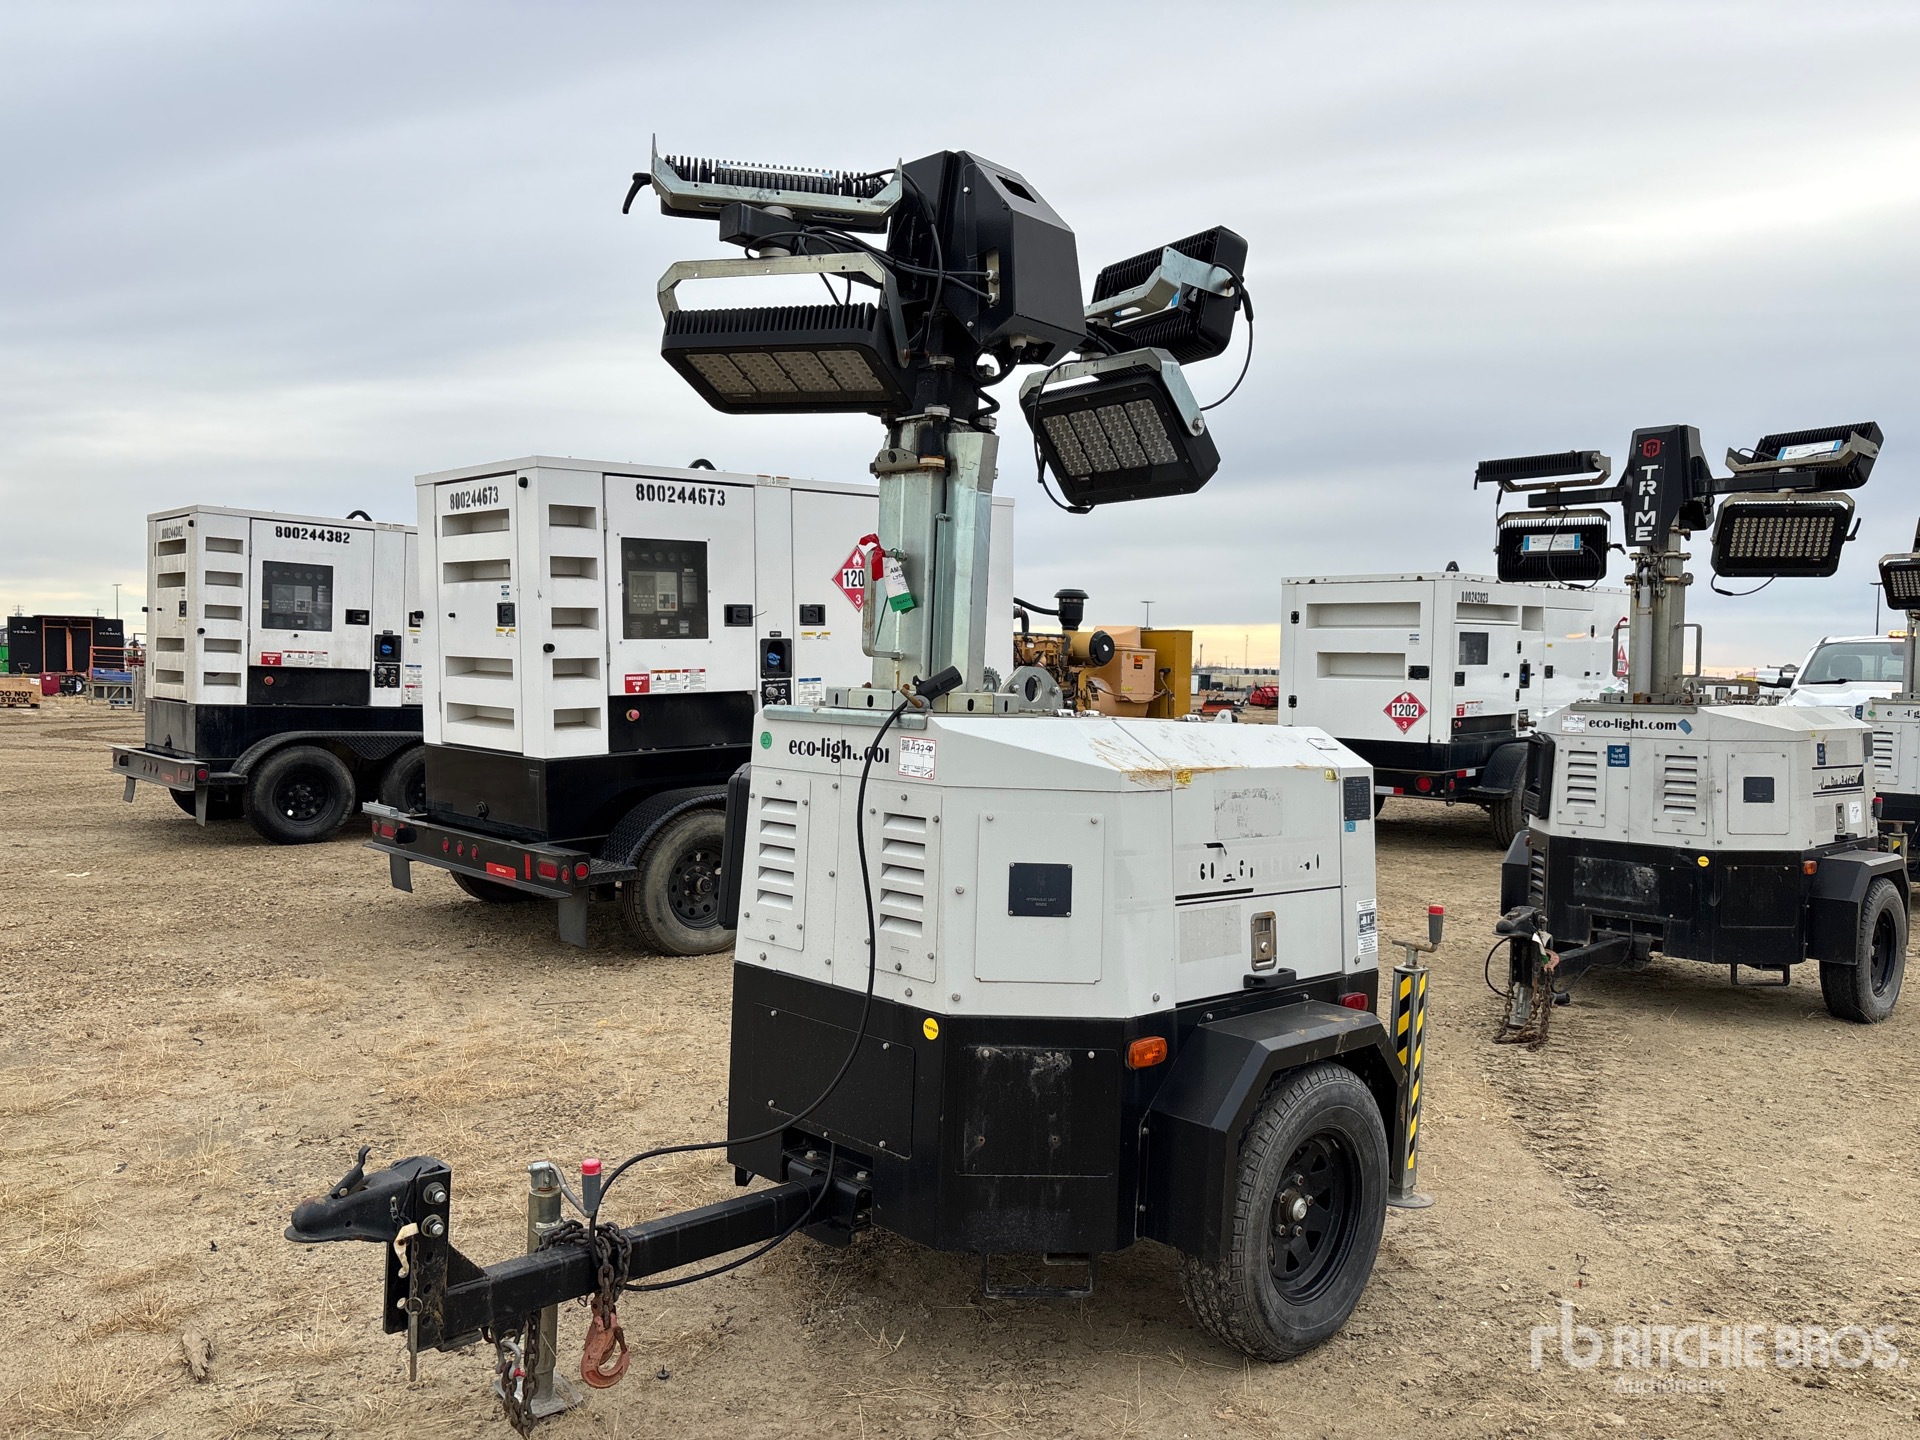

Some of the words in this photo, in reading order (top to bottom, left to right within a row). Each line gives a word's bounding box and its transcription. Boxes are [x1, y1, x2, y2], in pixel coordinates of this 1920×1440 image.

[449, 485, 500, 511] 800244673
[635, 483, 726, 507] 800244673
[1634, 464, 1660, 542] TRIME
[275, 525, 351, 544] 800244382
[843, 569, 865, 588] 120
[855, 594, 862, 605] 3
[0, 696, 30, 704] STACK
[14, 690, 34, 698] NOT
[1392, 704, 1418, 717] 1202
[1401, 721, 1408, 729] 3
[1588, 717, 1677, 732] eco-light.com
